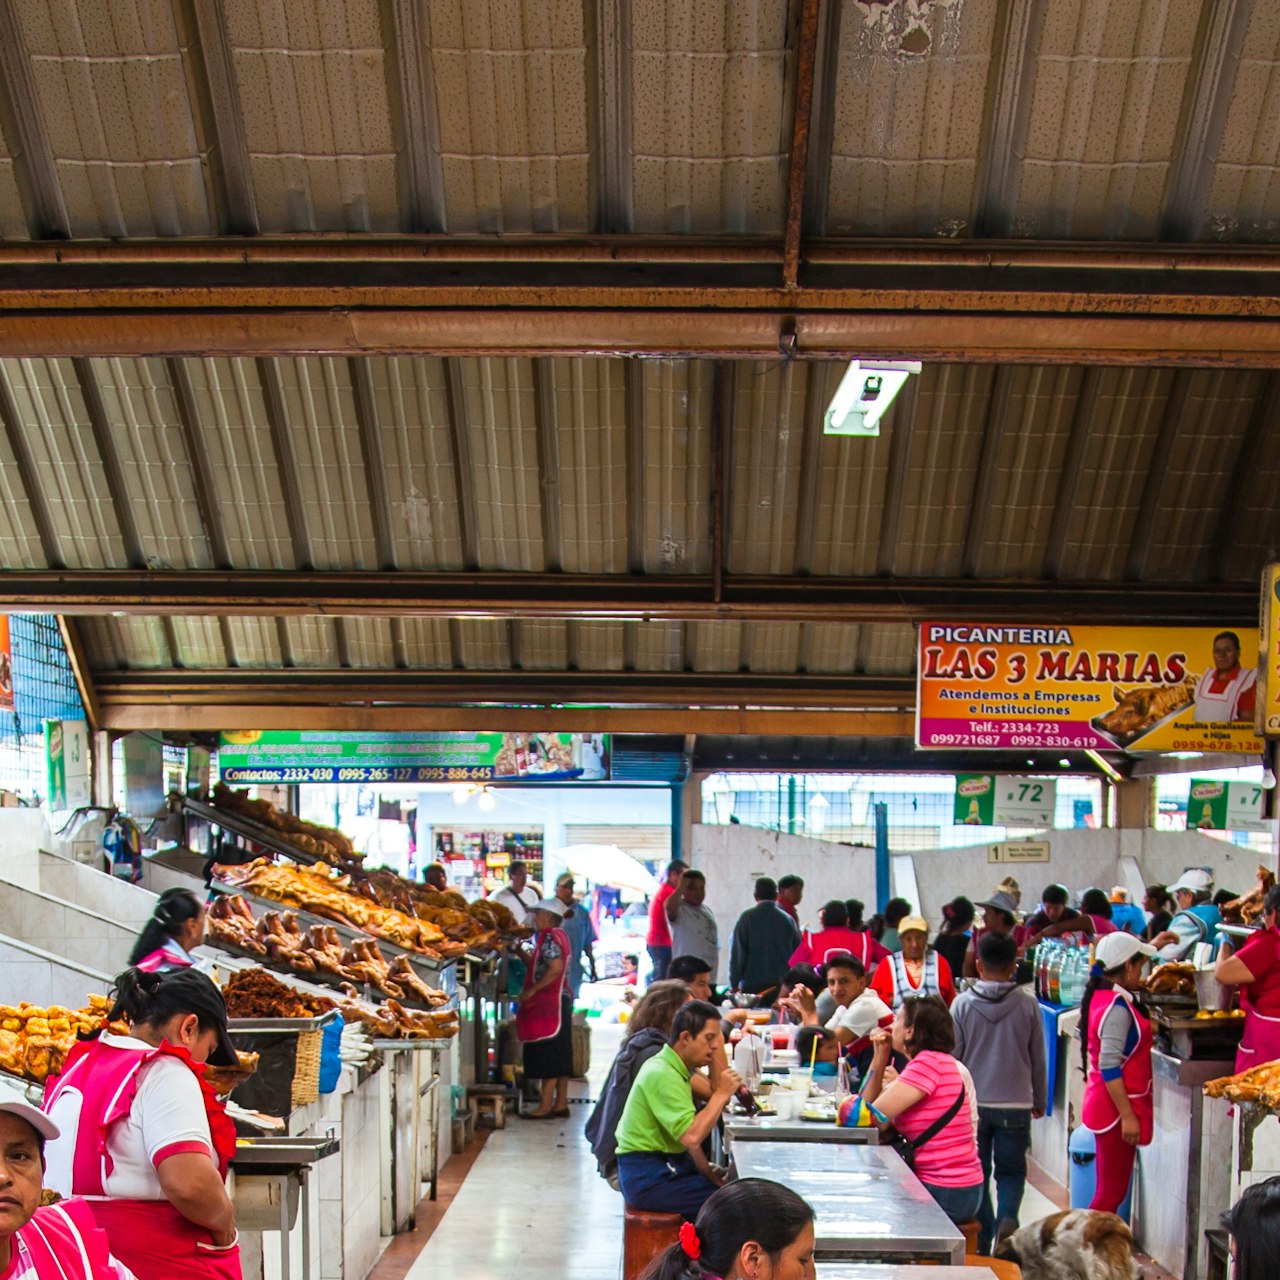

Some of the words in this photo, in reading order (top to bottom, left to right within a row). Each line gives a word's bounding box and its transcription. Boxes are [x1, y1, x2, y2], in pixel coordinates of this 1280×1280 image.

[929, 626, 1073, 645] PICANTERIA
[923, 646, 998, 680] LAS
[1006, 652, 1027, 683] 3
[1035, 650, 1188, 684] MARIAS
[939, 688, 1019, 701] Atendemos
[1023, 692, 1030, 701] a
[1034, 690, 1101, 704] Empresas
[969, 705, 978, 713] e
[981, 703, 1071, 716] Instituciones
[1001, 722, 1060, 734] 2334-723
[930, 734, 1001, 746] 099721687
[1011, 735, 1098, 748] 0992-830-619
[224, 767, 282, 781] Contactos:
[283, 767, 334, 781] 2332-030
[338, 767, 412, 780] 0995-265-127
[1240, 788, 1261, 805] #7
